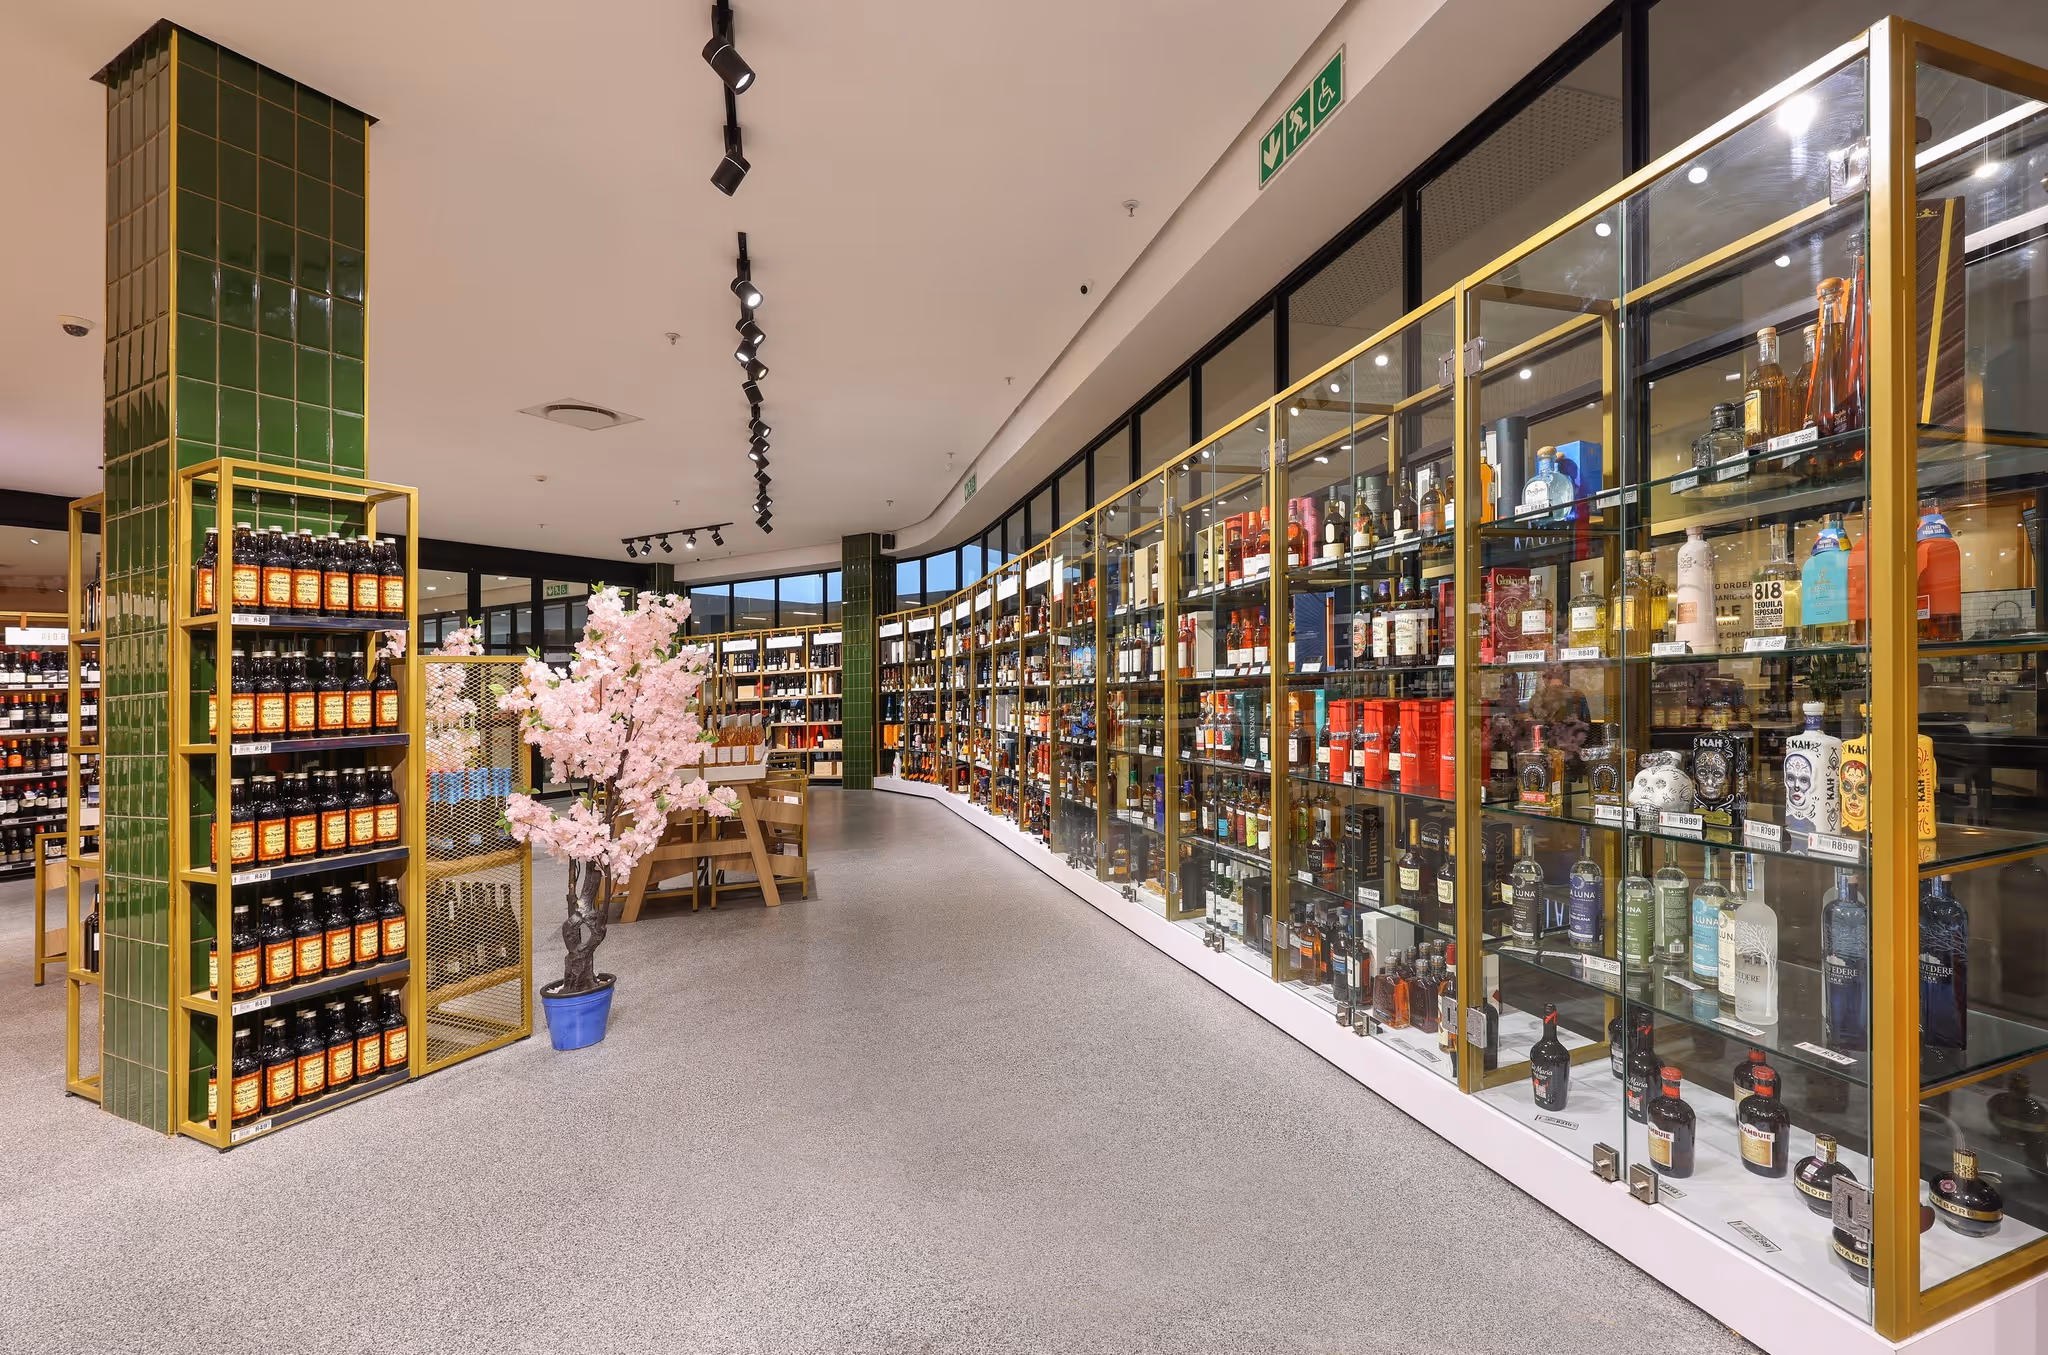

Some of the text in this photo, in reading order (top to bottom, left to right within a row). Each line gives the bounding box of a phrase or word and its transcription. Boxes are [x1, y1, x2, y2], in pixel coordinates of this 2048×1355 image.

[1754, 582, 1782, 601] 818
[1754, 600, 1783, 609] TEQUILA
[1754, 608, 1783, 616] REPOSADO
[1700, 738, 1723, 748] KAH
[1791, 739, 1811, 750] KAH
[1848, 744, 1867, 756] KAH
[1826, 778, 1835, 800] KAH
[1918, 779, 1926, 802] KAH
[1679, 816, 1698, 826] R999
[1759, 828, 1776, 837] R799
[1365, 814, 1379, 876] Hennessy
[1831, 840, 1853, 852] R899
[1491, 831, 1507, 905] Hennessy
[1515, 889, 1536, 898] LUNA
[1574, 890, 1595, 899] LUNA
[1695, 915, 1718, 926] LUNA
[1718, 930, 1735, 942] LUN
[1535, 1064, 1553, 1076] Maria
[1628, 1076, 1648, 1088] Maria
[1739, 1123, 1772, 1141] RAMBUIE
[1795, 1179, 1833, 1200] AMBORD
[1930, 1192, 1973, 1217] AMBORD
[1835, 1242, 1869, 1266] CHAMB
